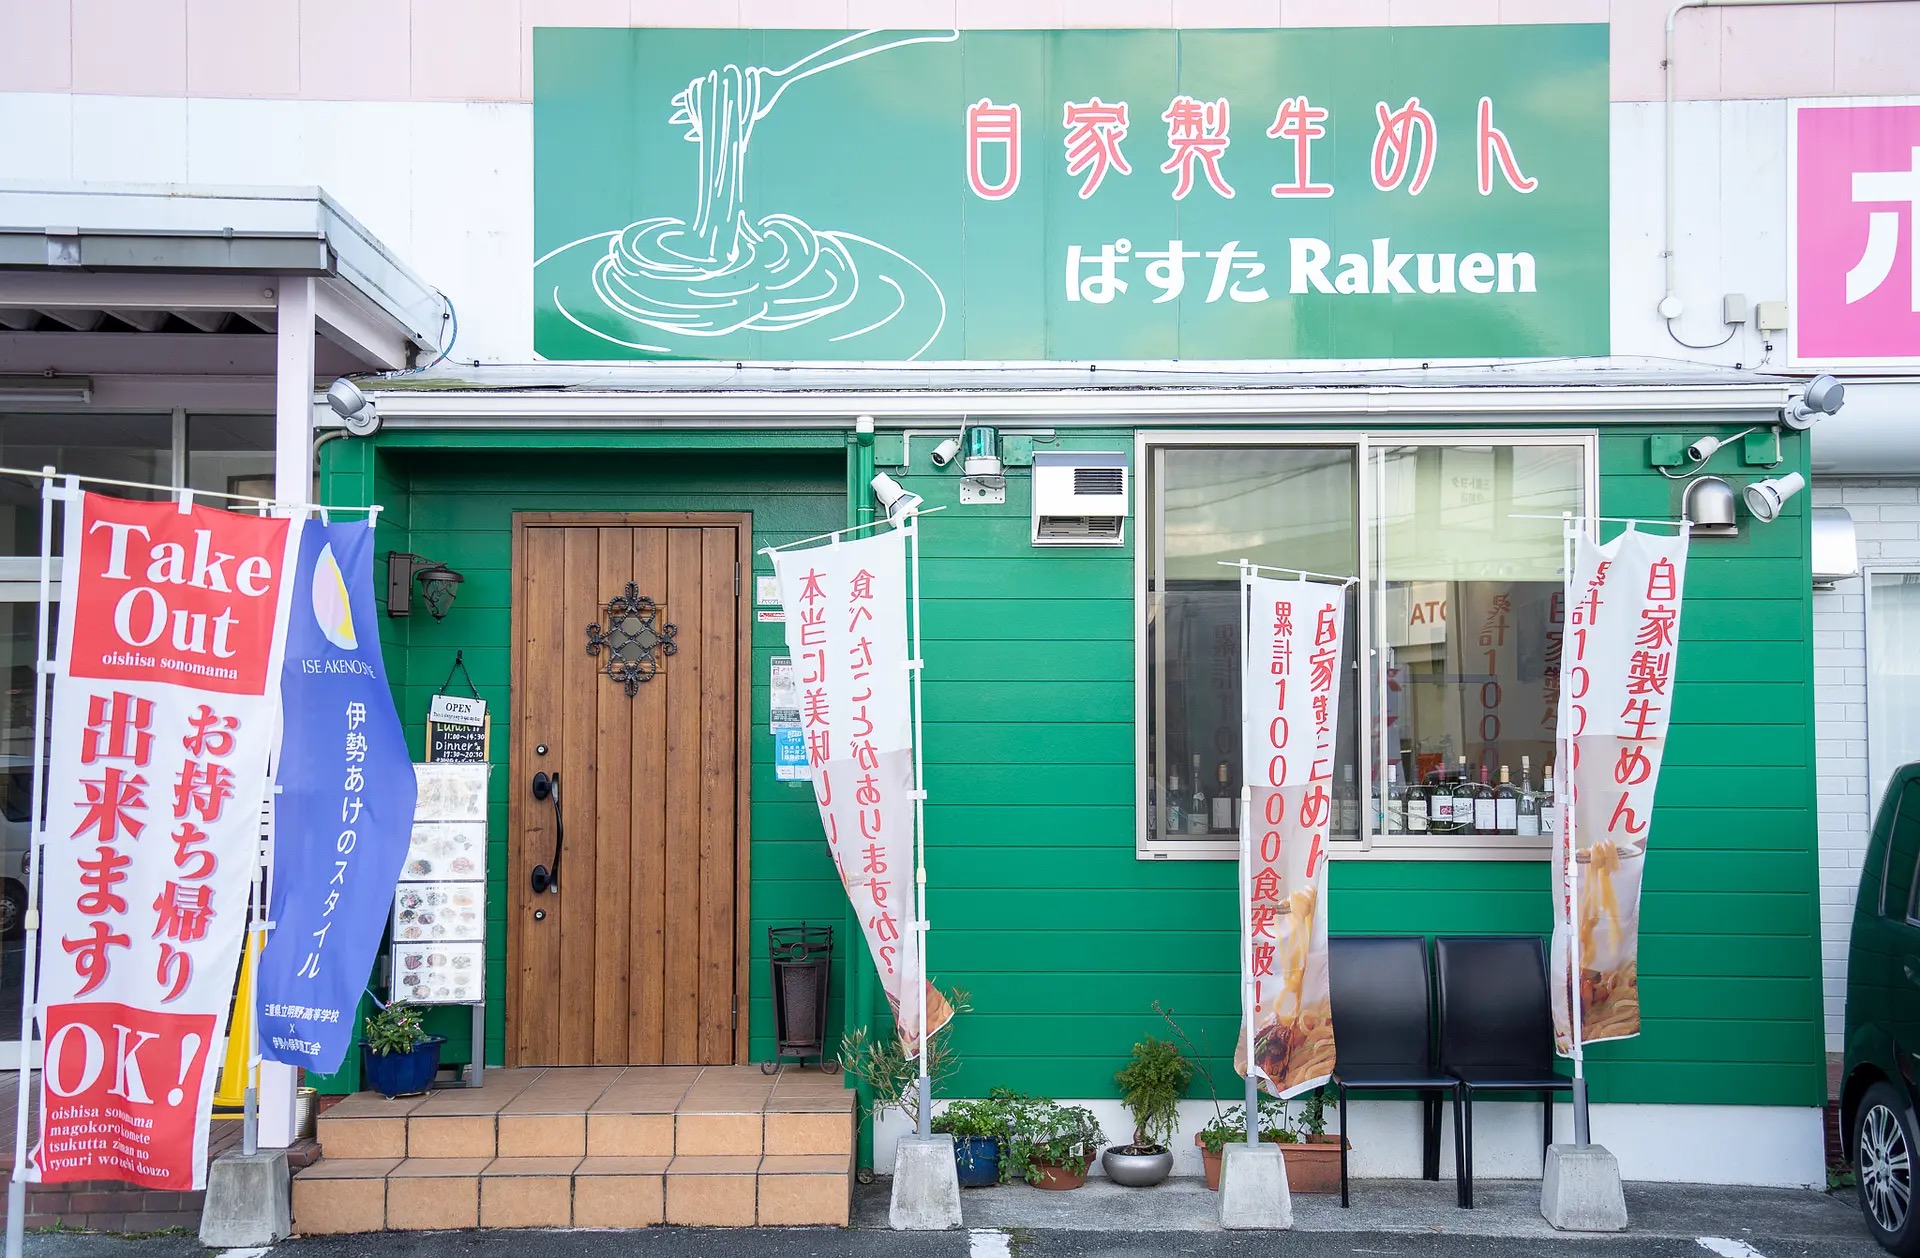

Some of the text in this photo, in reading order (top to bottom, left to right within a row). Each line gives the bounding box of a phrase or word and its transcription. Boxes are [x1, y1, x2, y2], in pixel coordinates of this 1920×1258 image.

[966, 95, 1538, 201] 自家製生めん
[1065, 237, 1537, 303] ぱすた Rakuen
[89, 519, 272, 597] Take
[113, 587, 240, 658] Out
[102, 651, 238, 680] oishisa sonomama
[302, 659, 322, 674] ISE
[1608, 557, 1676, 834] 自家製生めん
[445, 702, 472, 714] OPEN
[435, 741, 473, 751] Dinner
[61, 690, 157, 998] 出来ます
[152, 704, 240, 1003] お持ち帰り
[297, 701, 368, 979] 伊勢あけのスタイル
[45, 1022, 202, 1107] OK!
[49, 1120, 120, 1137] magokoro
[51, 1105, 99, 1120] oishisa
[49, 1138, 107, 1153] tsukutta
[136, 1150, 149, 1160] no
[50, 1152, 92, 1171] ryouri
[136, 1161, 170, 1178] douzo
